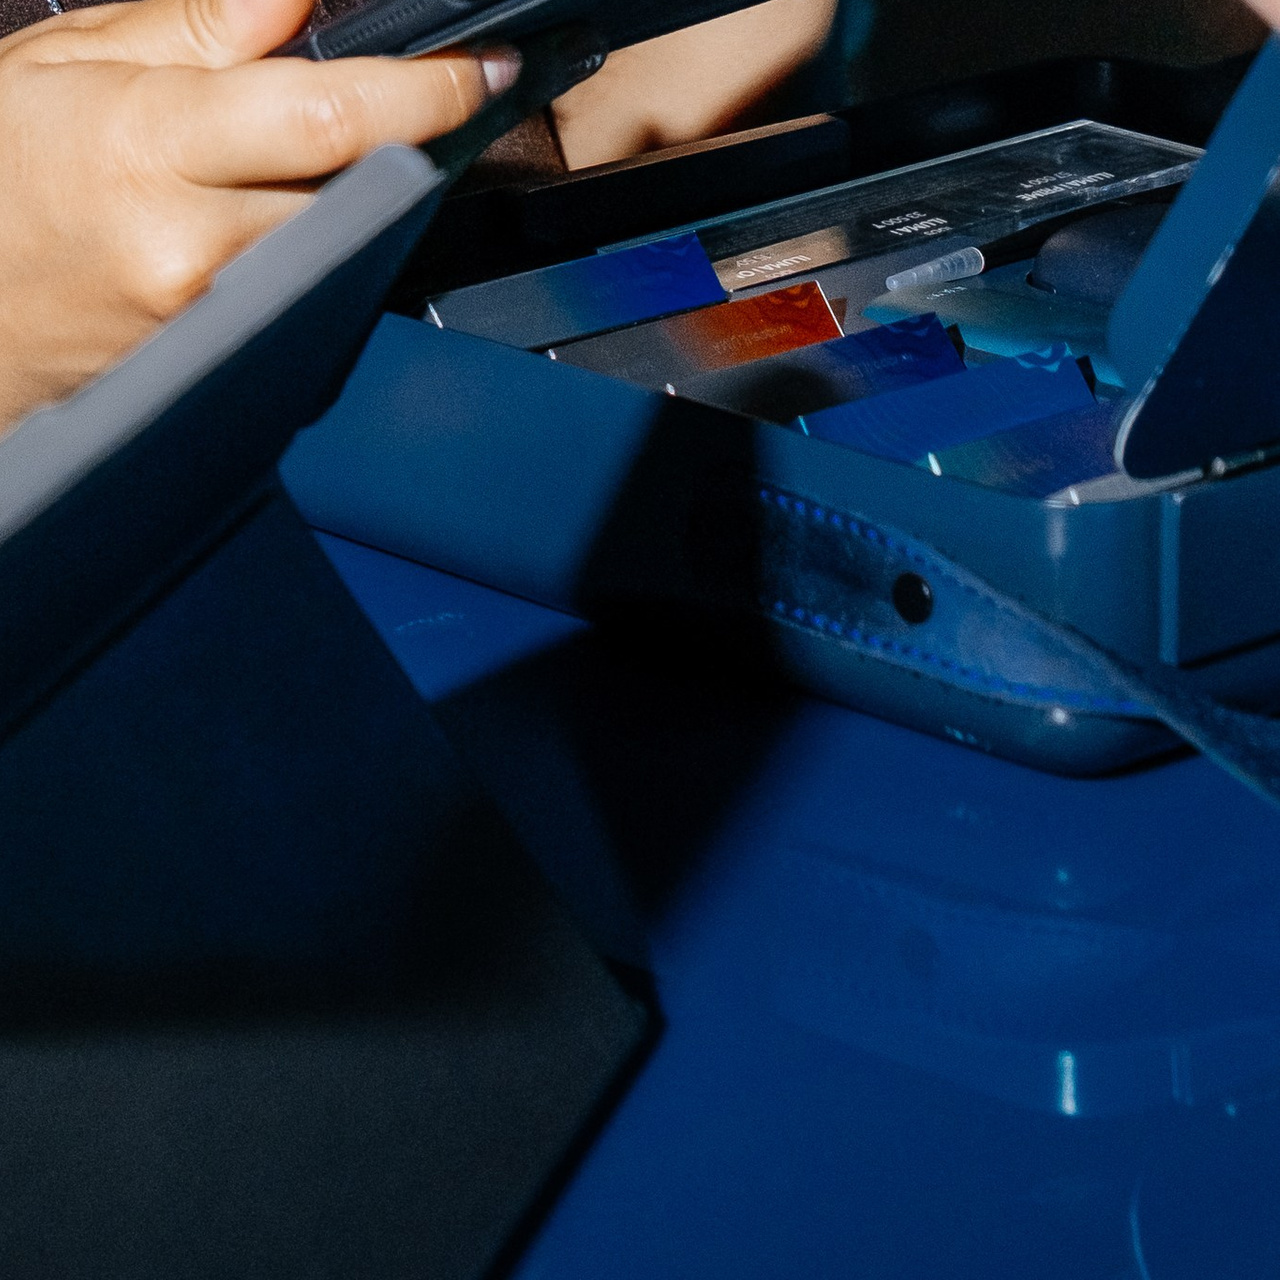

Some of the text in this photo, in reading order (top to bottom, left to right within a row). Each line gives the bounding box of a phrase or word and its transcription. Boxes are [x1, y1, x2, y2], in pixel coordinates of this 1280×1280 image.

[1065, 171, 1115, 187] ILUMA
[1015, 185, 1066, 201] PRIME
[895, 217, 948, 233] ILUMA
[761, 254, 812, 272] ILUMA
